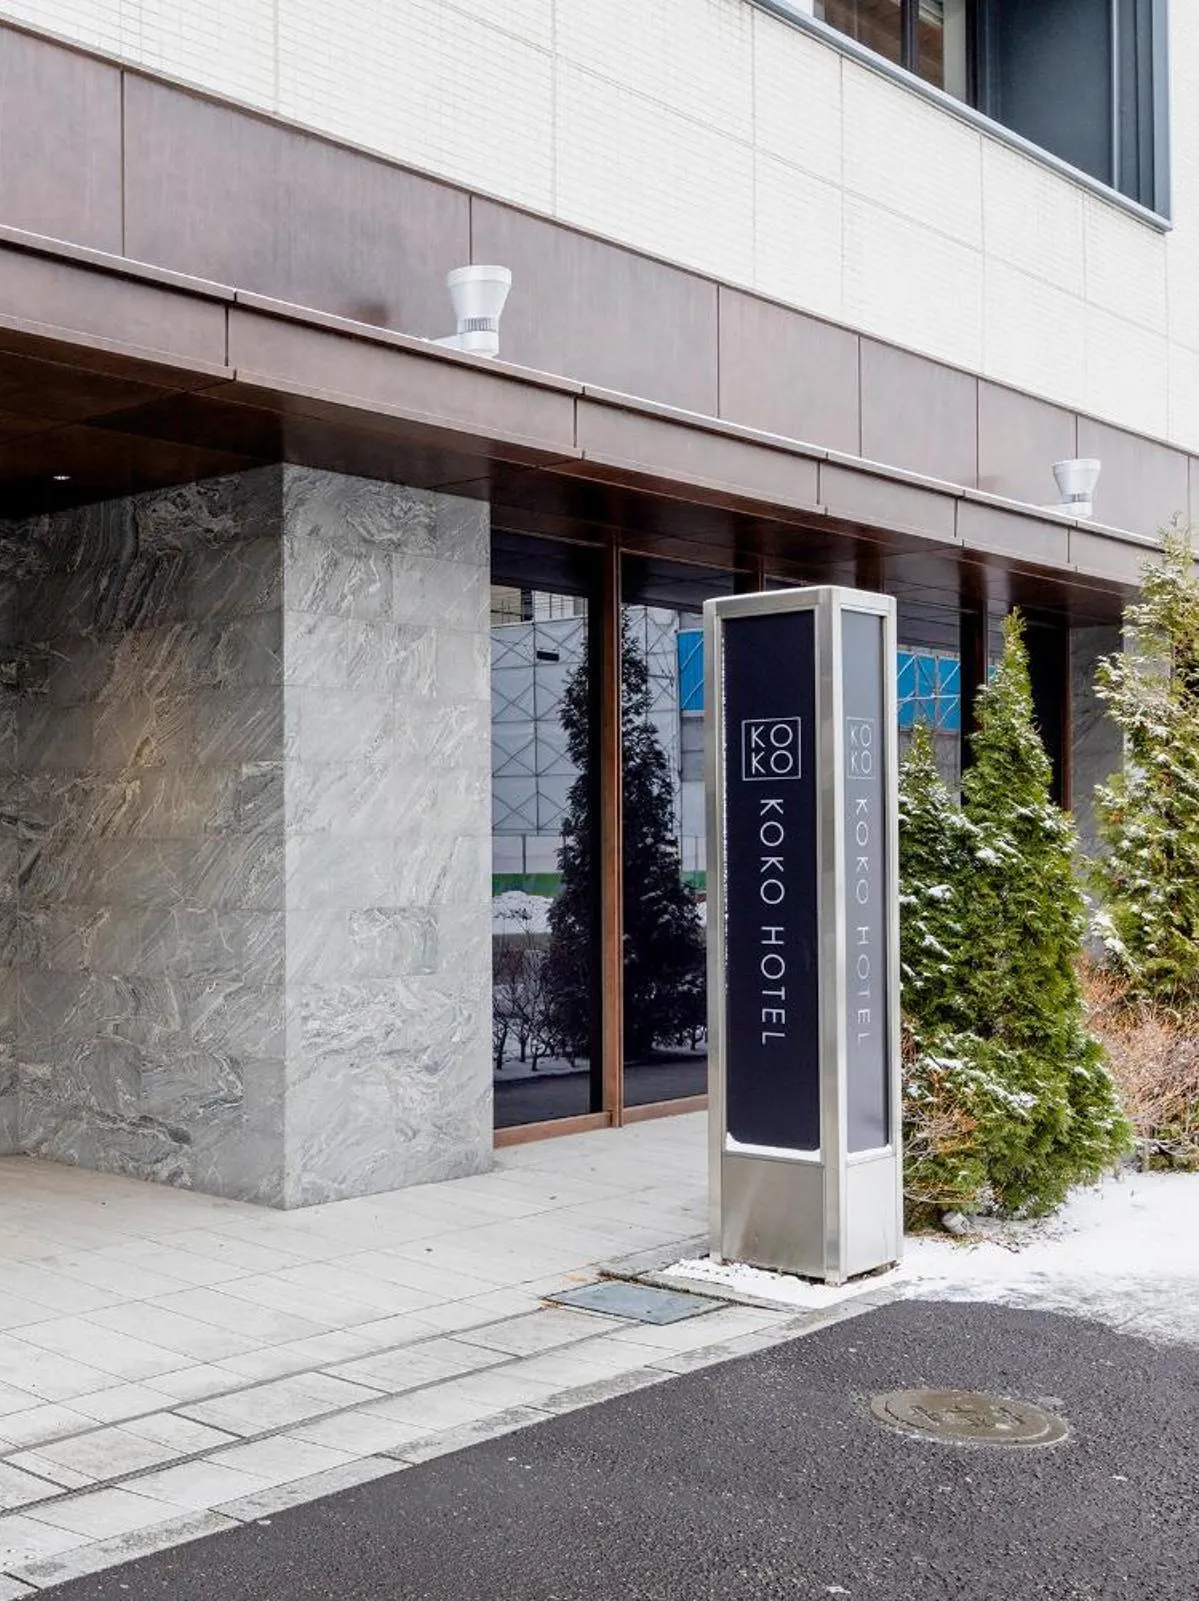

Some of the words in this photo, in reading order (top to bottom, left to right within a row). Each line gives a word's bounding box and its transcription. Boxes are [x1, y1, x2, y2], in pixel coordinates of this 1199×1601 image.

[760, 798, 784, 905] KOKO
[856, 798, 869, 905] KOKO
[760, 926, 786, 1045] HOTEL
[857, 926, 871, 1044] HOTEL
